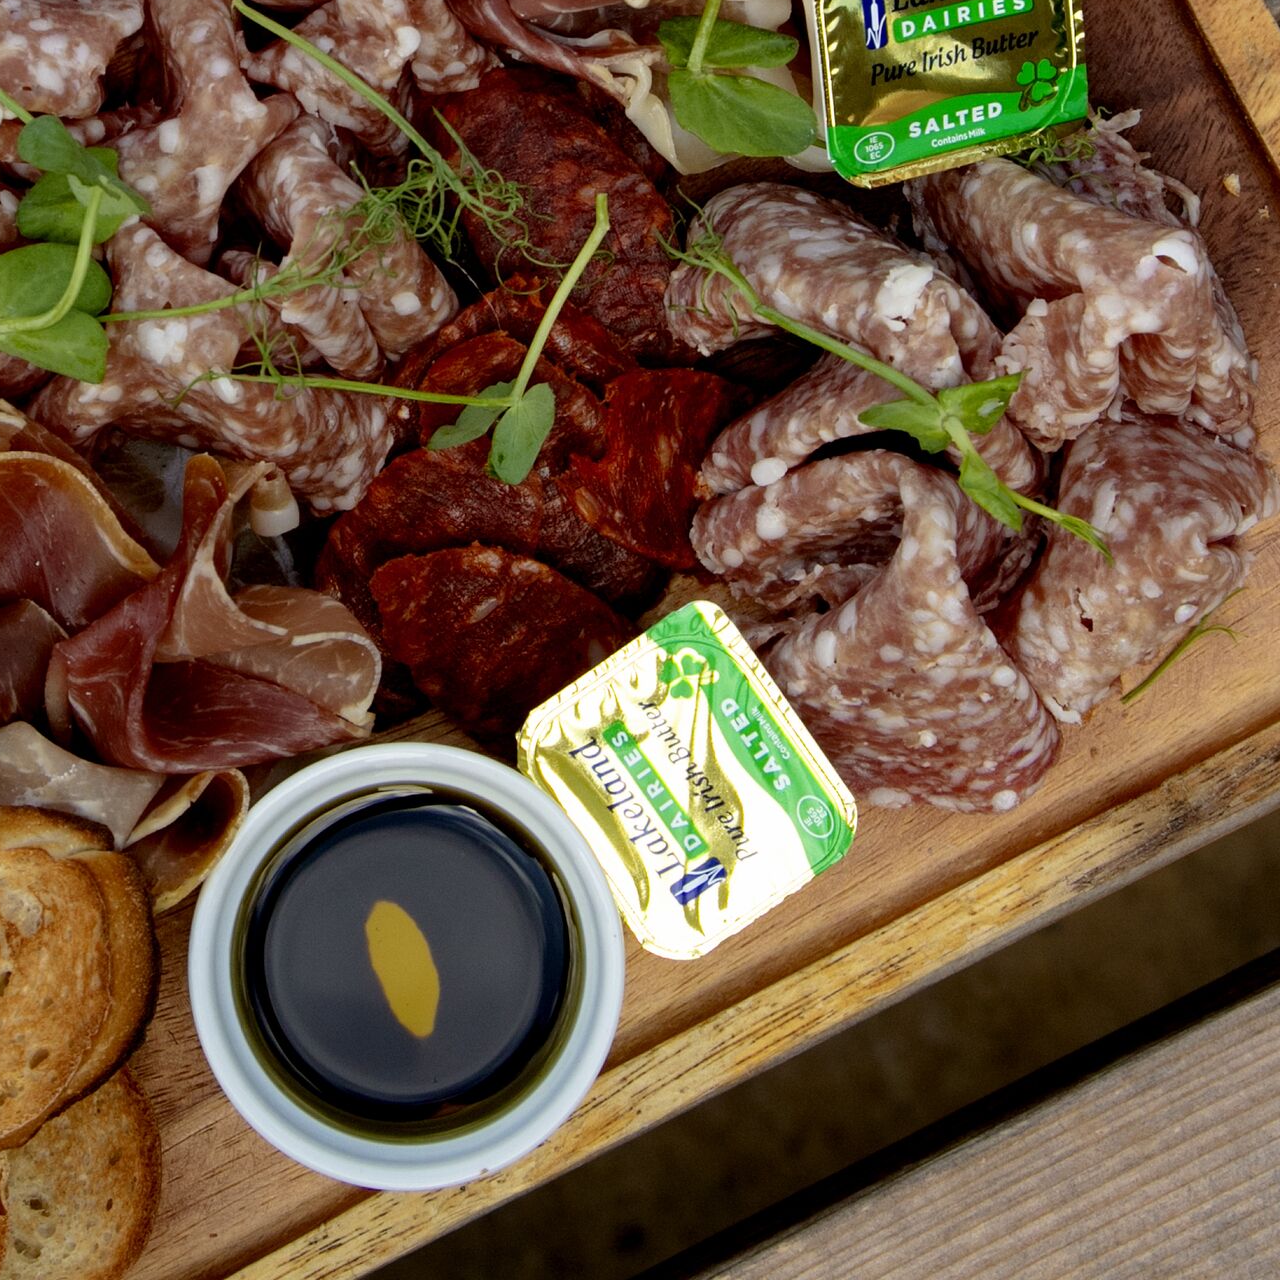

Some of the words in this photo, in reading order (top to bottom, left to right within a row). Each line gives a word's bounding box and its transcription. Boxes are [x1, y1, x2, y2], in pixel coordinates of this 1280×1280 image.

[871, 60, 917, 86] Pure
[922, 43, 966, 74] Irish
[971, 28, 1039, 60] Butter
[909, 102, 1003, 138] SALTED
[931, 134, 968, 148] Contains
[968, 127, 986, 139] Milk
[638, 700, 691, 764] Butter
[751, 706, 766, 726] Milk
[721, 697, 791, 790] SALTED
[765, 724, 791, 760] Contains
[568, 736, 686, 878] Lakeland
[611, 730, 702, 852] DAIRIES
[685, 763, 726, 813] Irish
[717, 811, 758, 862] Pure
